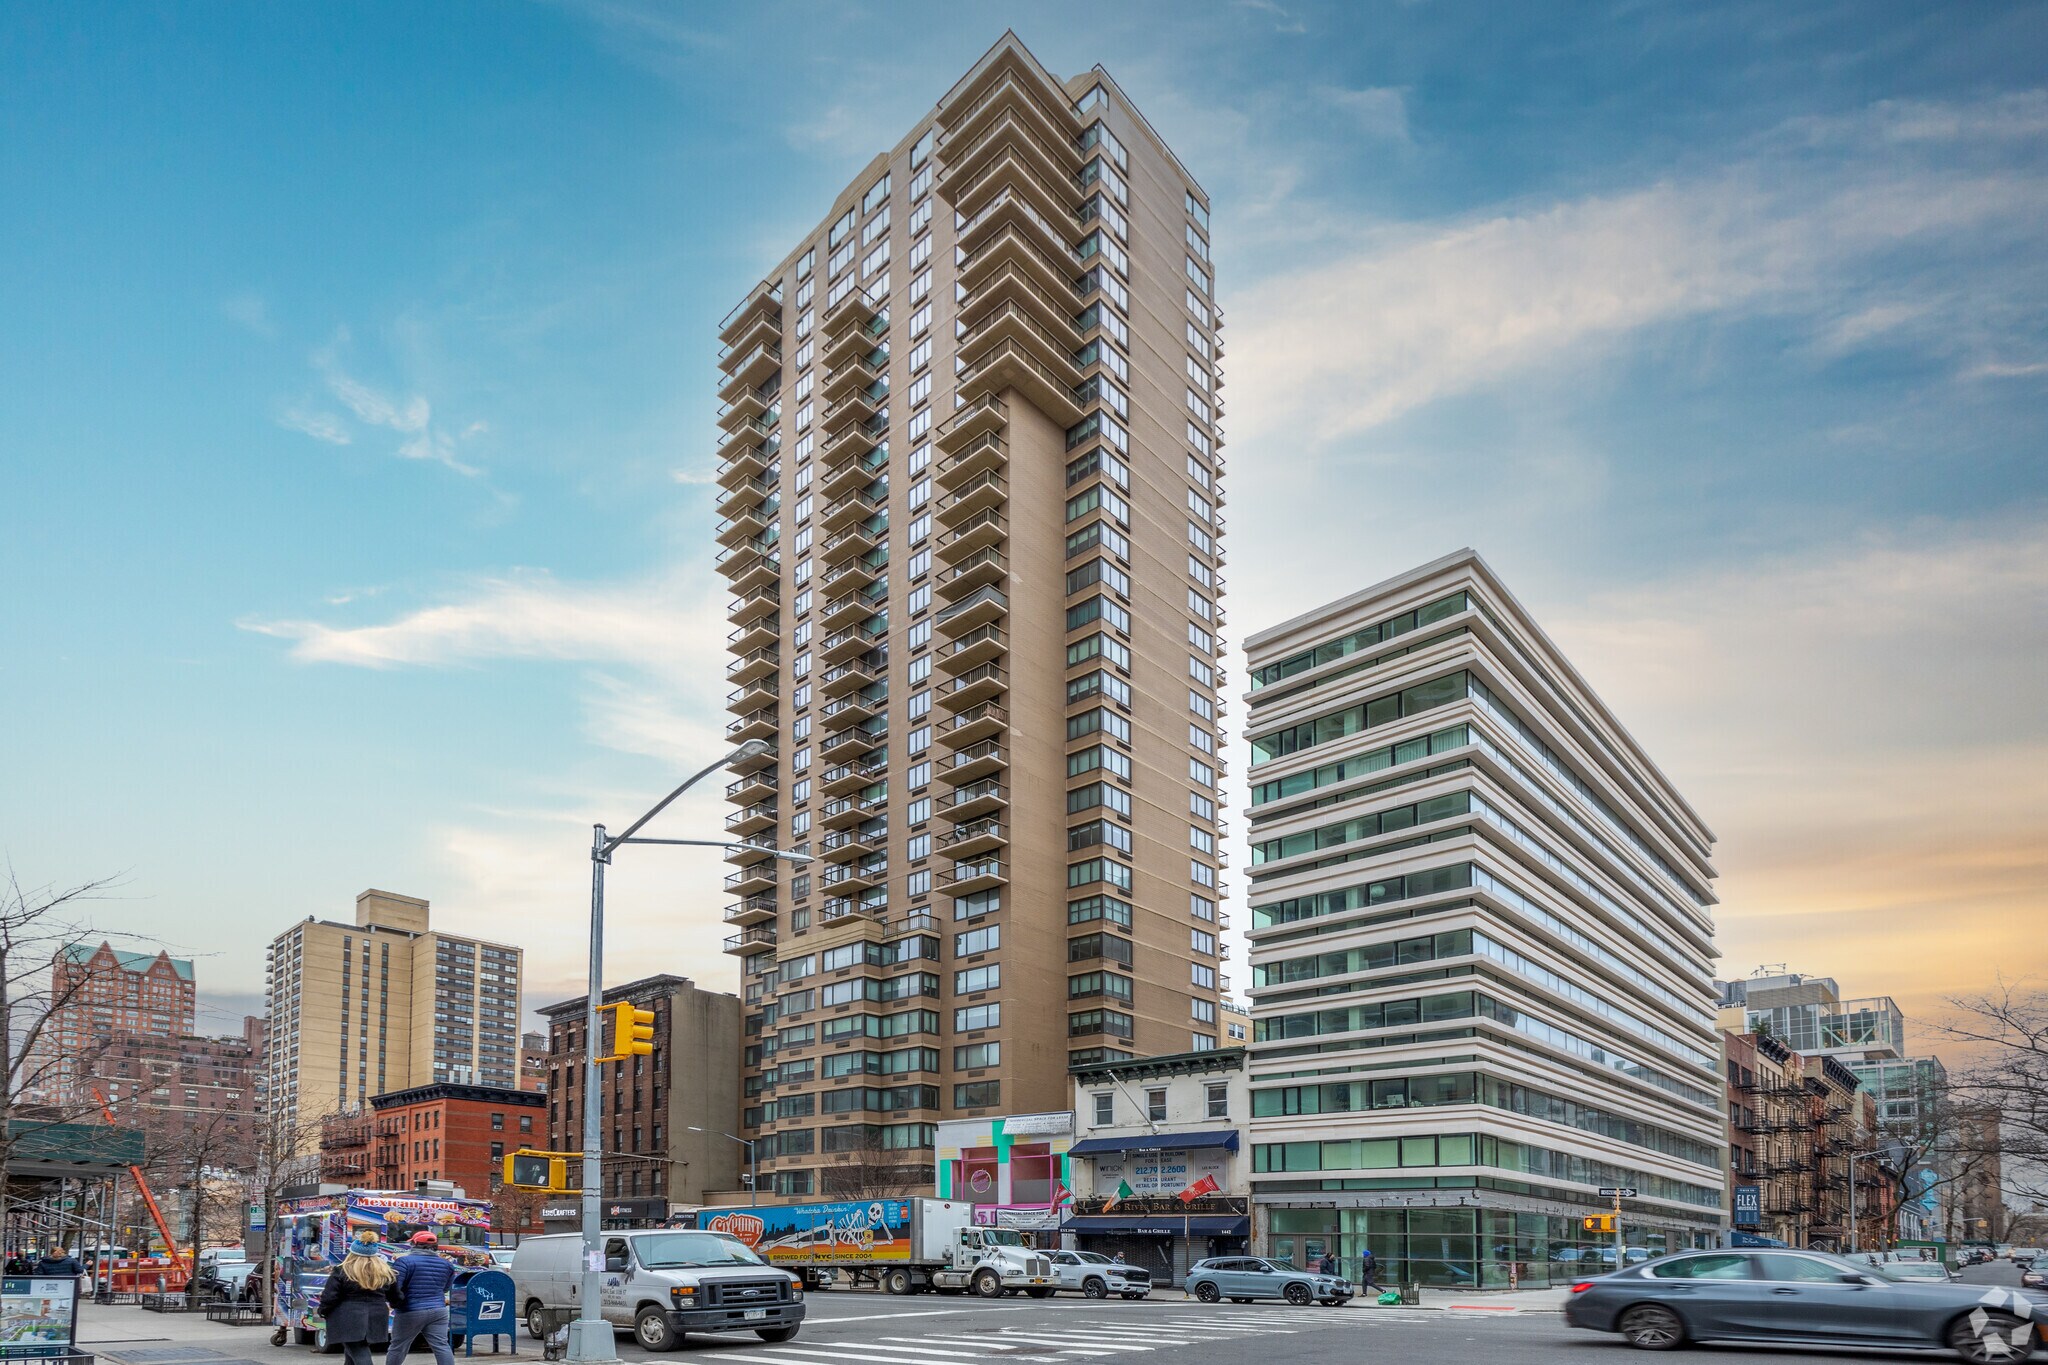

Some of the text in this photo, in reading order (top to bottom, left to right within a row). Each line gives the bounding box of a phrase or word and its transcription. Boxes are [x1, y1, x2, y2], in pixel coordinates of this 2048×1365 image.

[1135, 1165, 1186, 1175] 212.792.2600
[357, 1197, 419, 1209] Mexican
[1737, 1194, 1757, 1206] FLEX
[1124, 1203, 1149, 1211] RIVER
[1153, 1202, 1170, 1211] BAR
[1184, 1202, 1216, 1211] GRILLE
